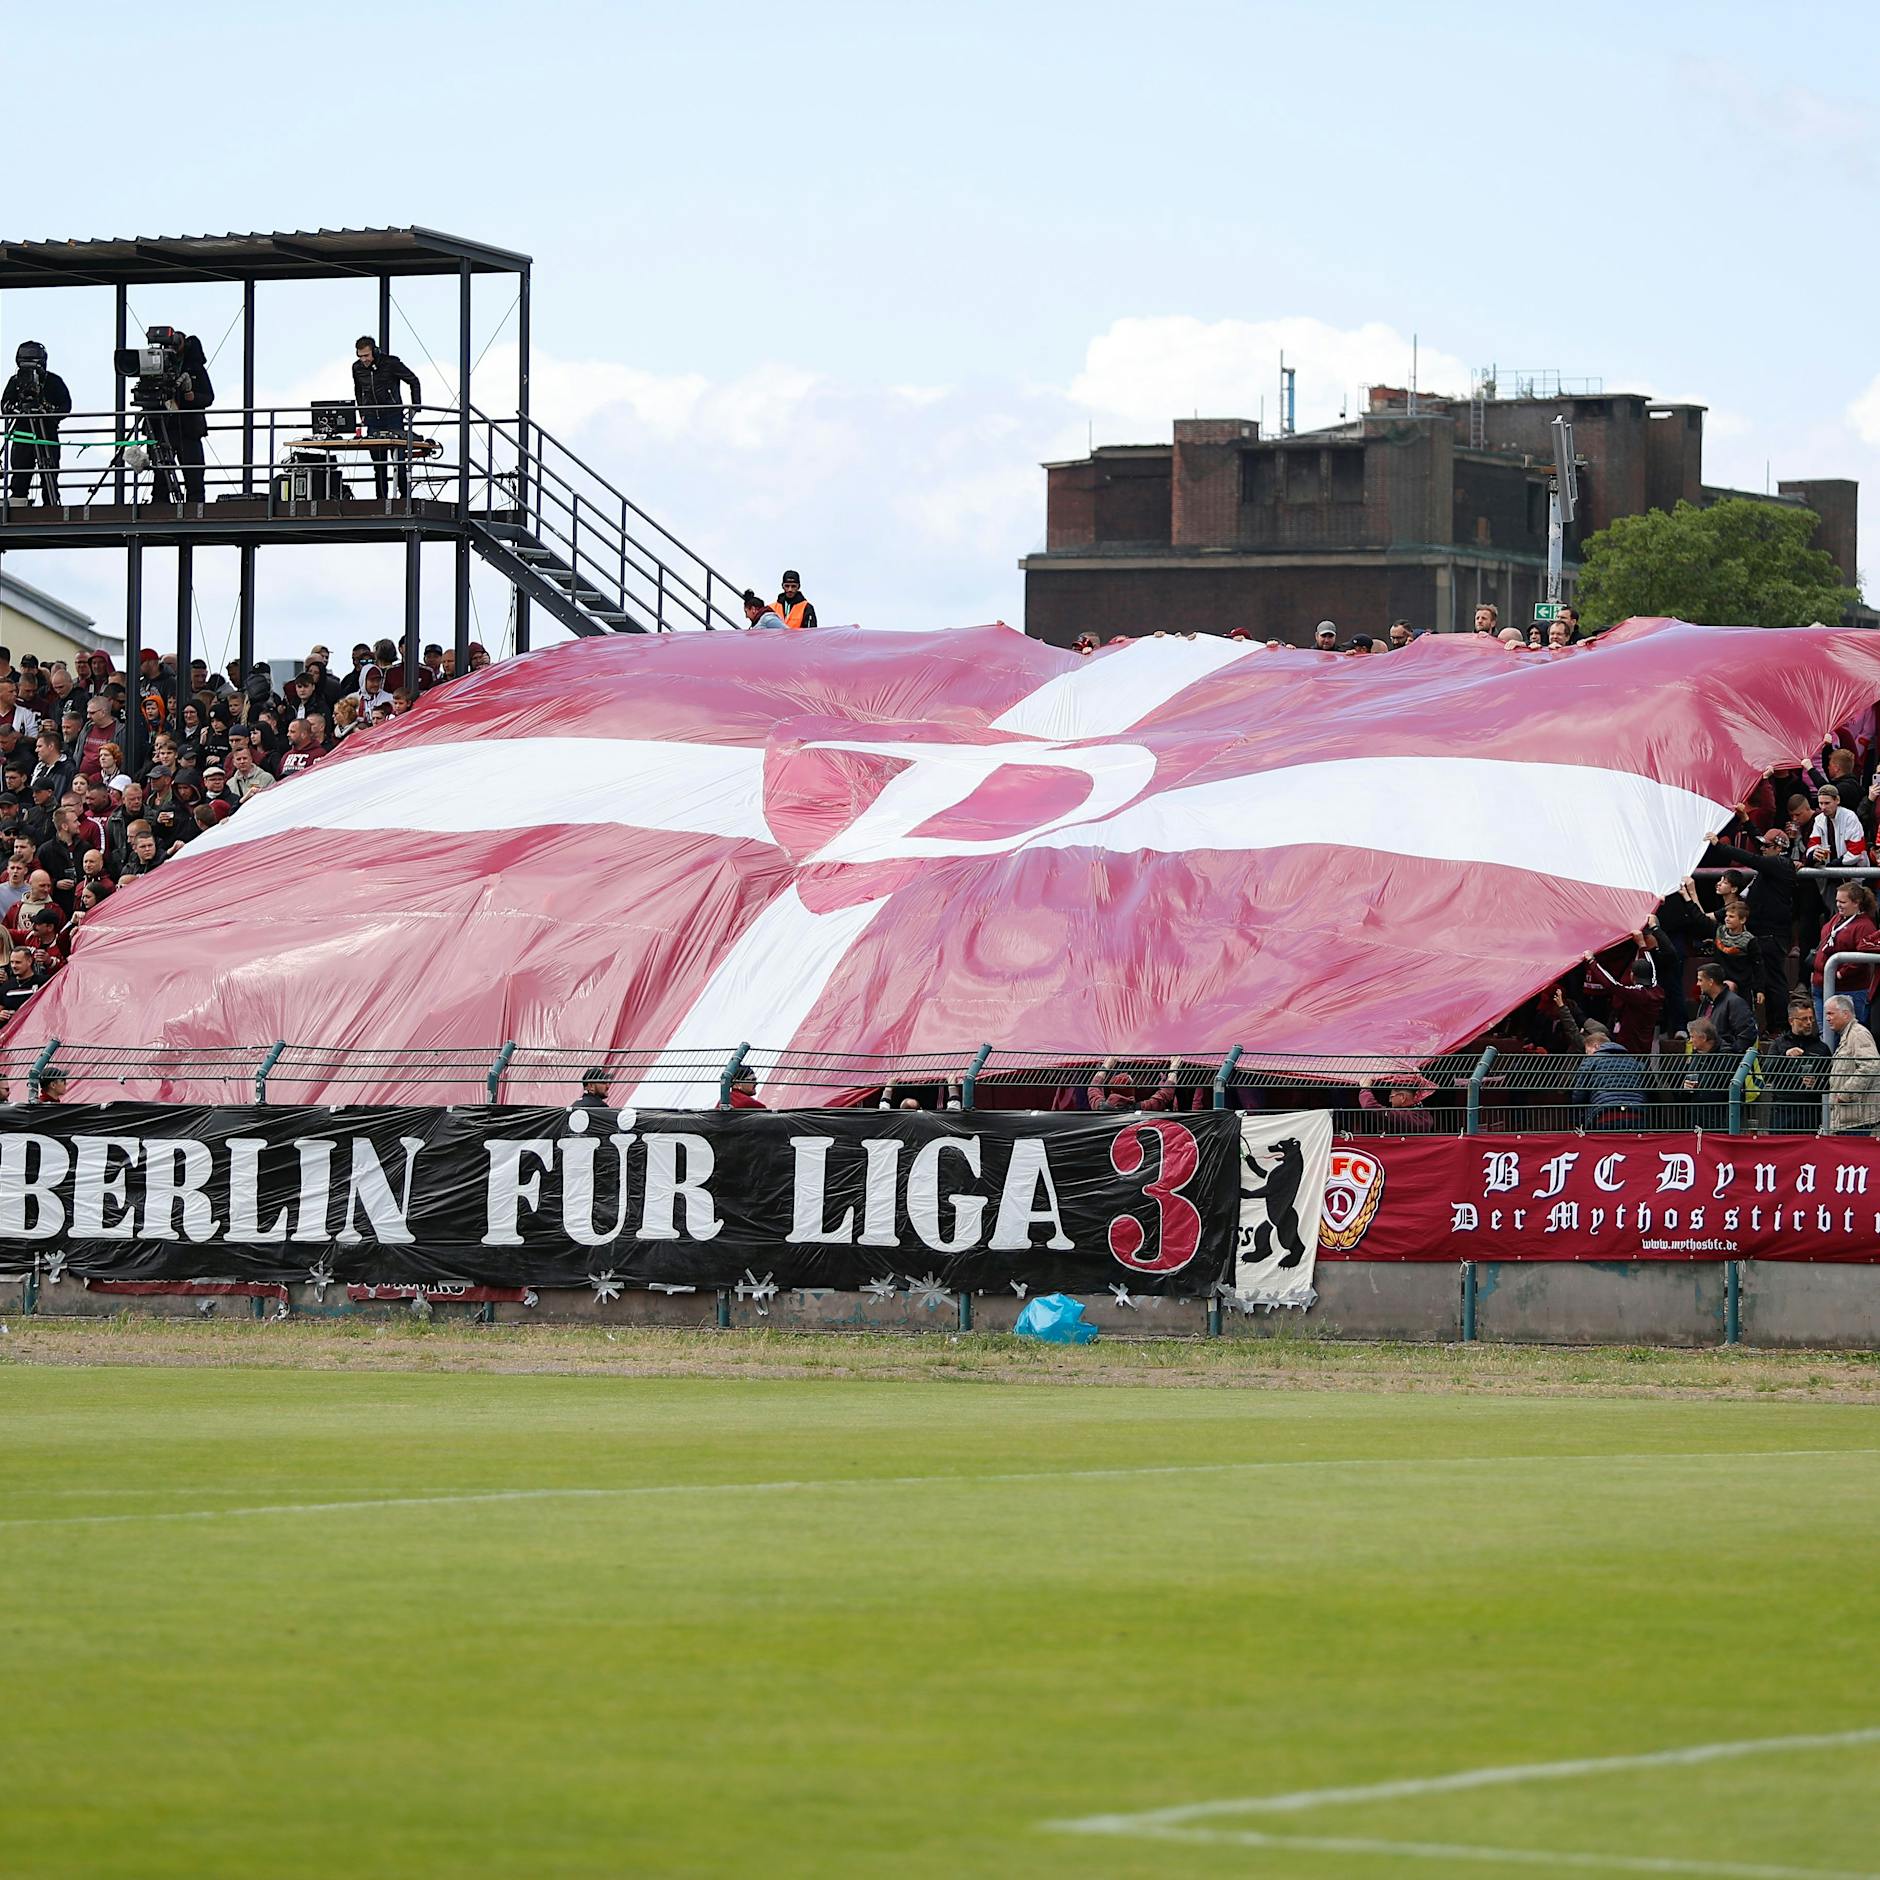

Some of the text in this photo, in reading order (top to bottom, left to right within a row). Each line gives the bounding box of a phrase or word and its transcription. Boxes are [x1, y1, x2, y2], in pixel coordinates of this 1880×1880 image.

[0, 1108, 1202, 1275] BERLIN FÜR LIGA 3
[1482, 1150, 1870, 1199] BFC Dynam
[1450, 1201, 1526, 1233] Der
[1544, 1200, 1705, 1236] Mythos
[1723, 1203, 1855, 1233] stirbt
